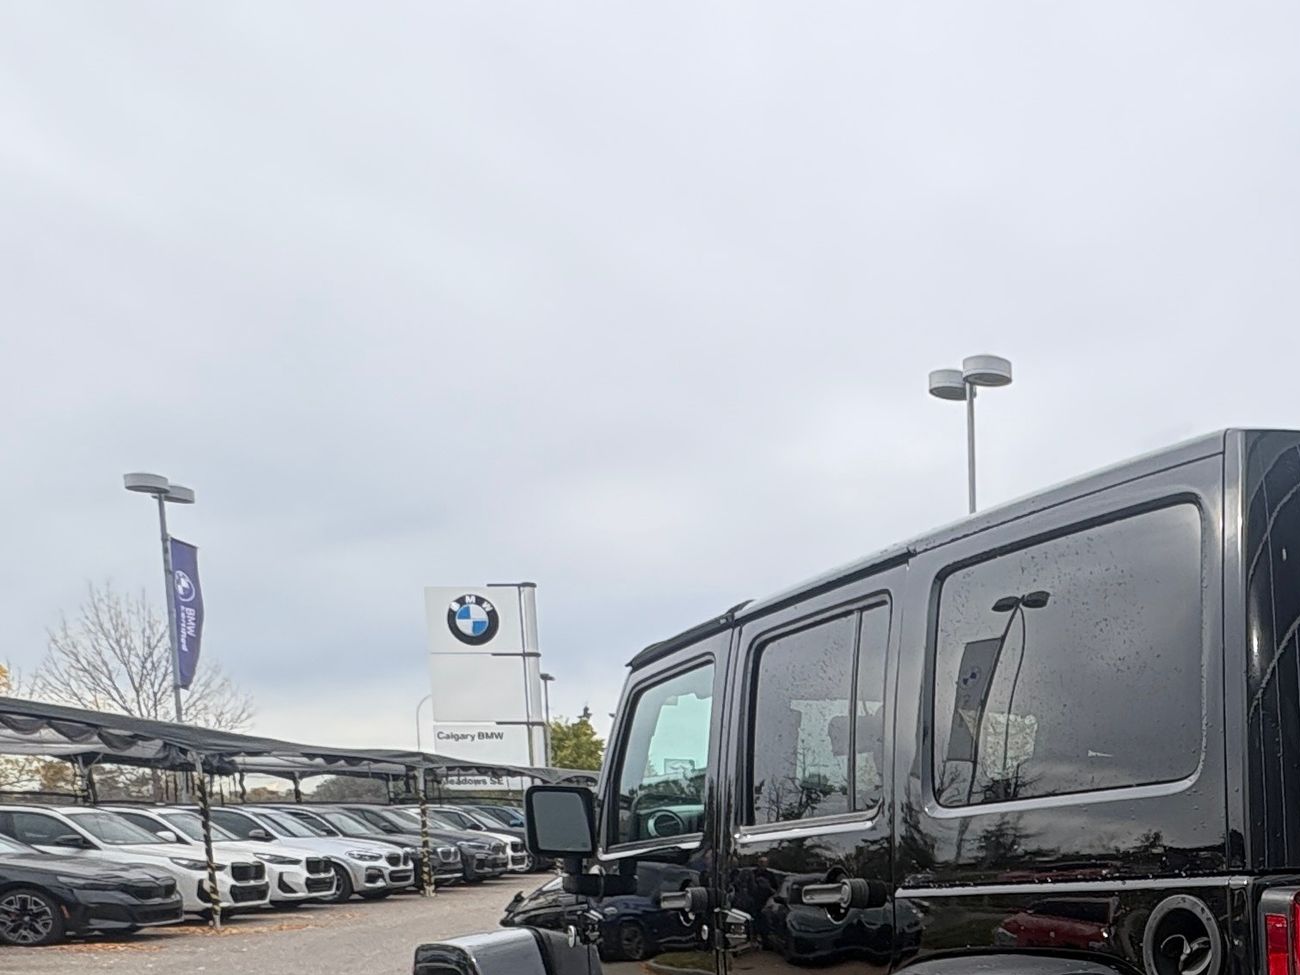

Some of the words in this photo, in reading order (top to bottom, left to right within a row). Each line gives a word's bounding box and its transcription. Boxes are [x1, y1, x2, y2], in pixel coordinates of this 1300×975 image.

[450, 595, 493, 612] BMW
[185, 607, 196, 637] BMW
[437, 731, 476, 742] Calgary
[477, 731, 504, 740] BMW
